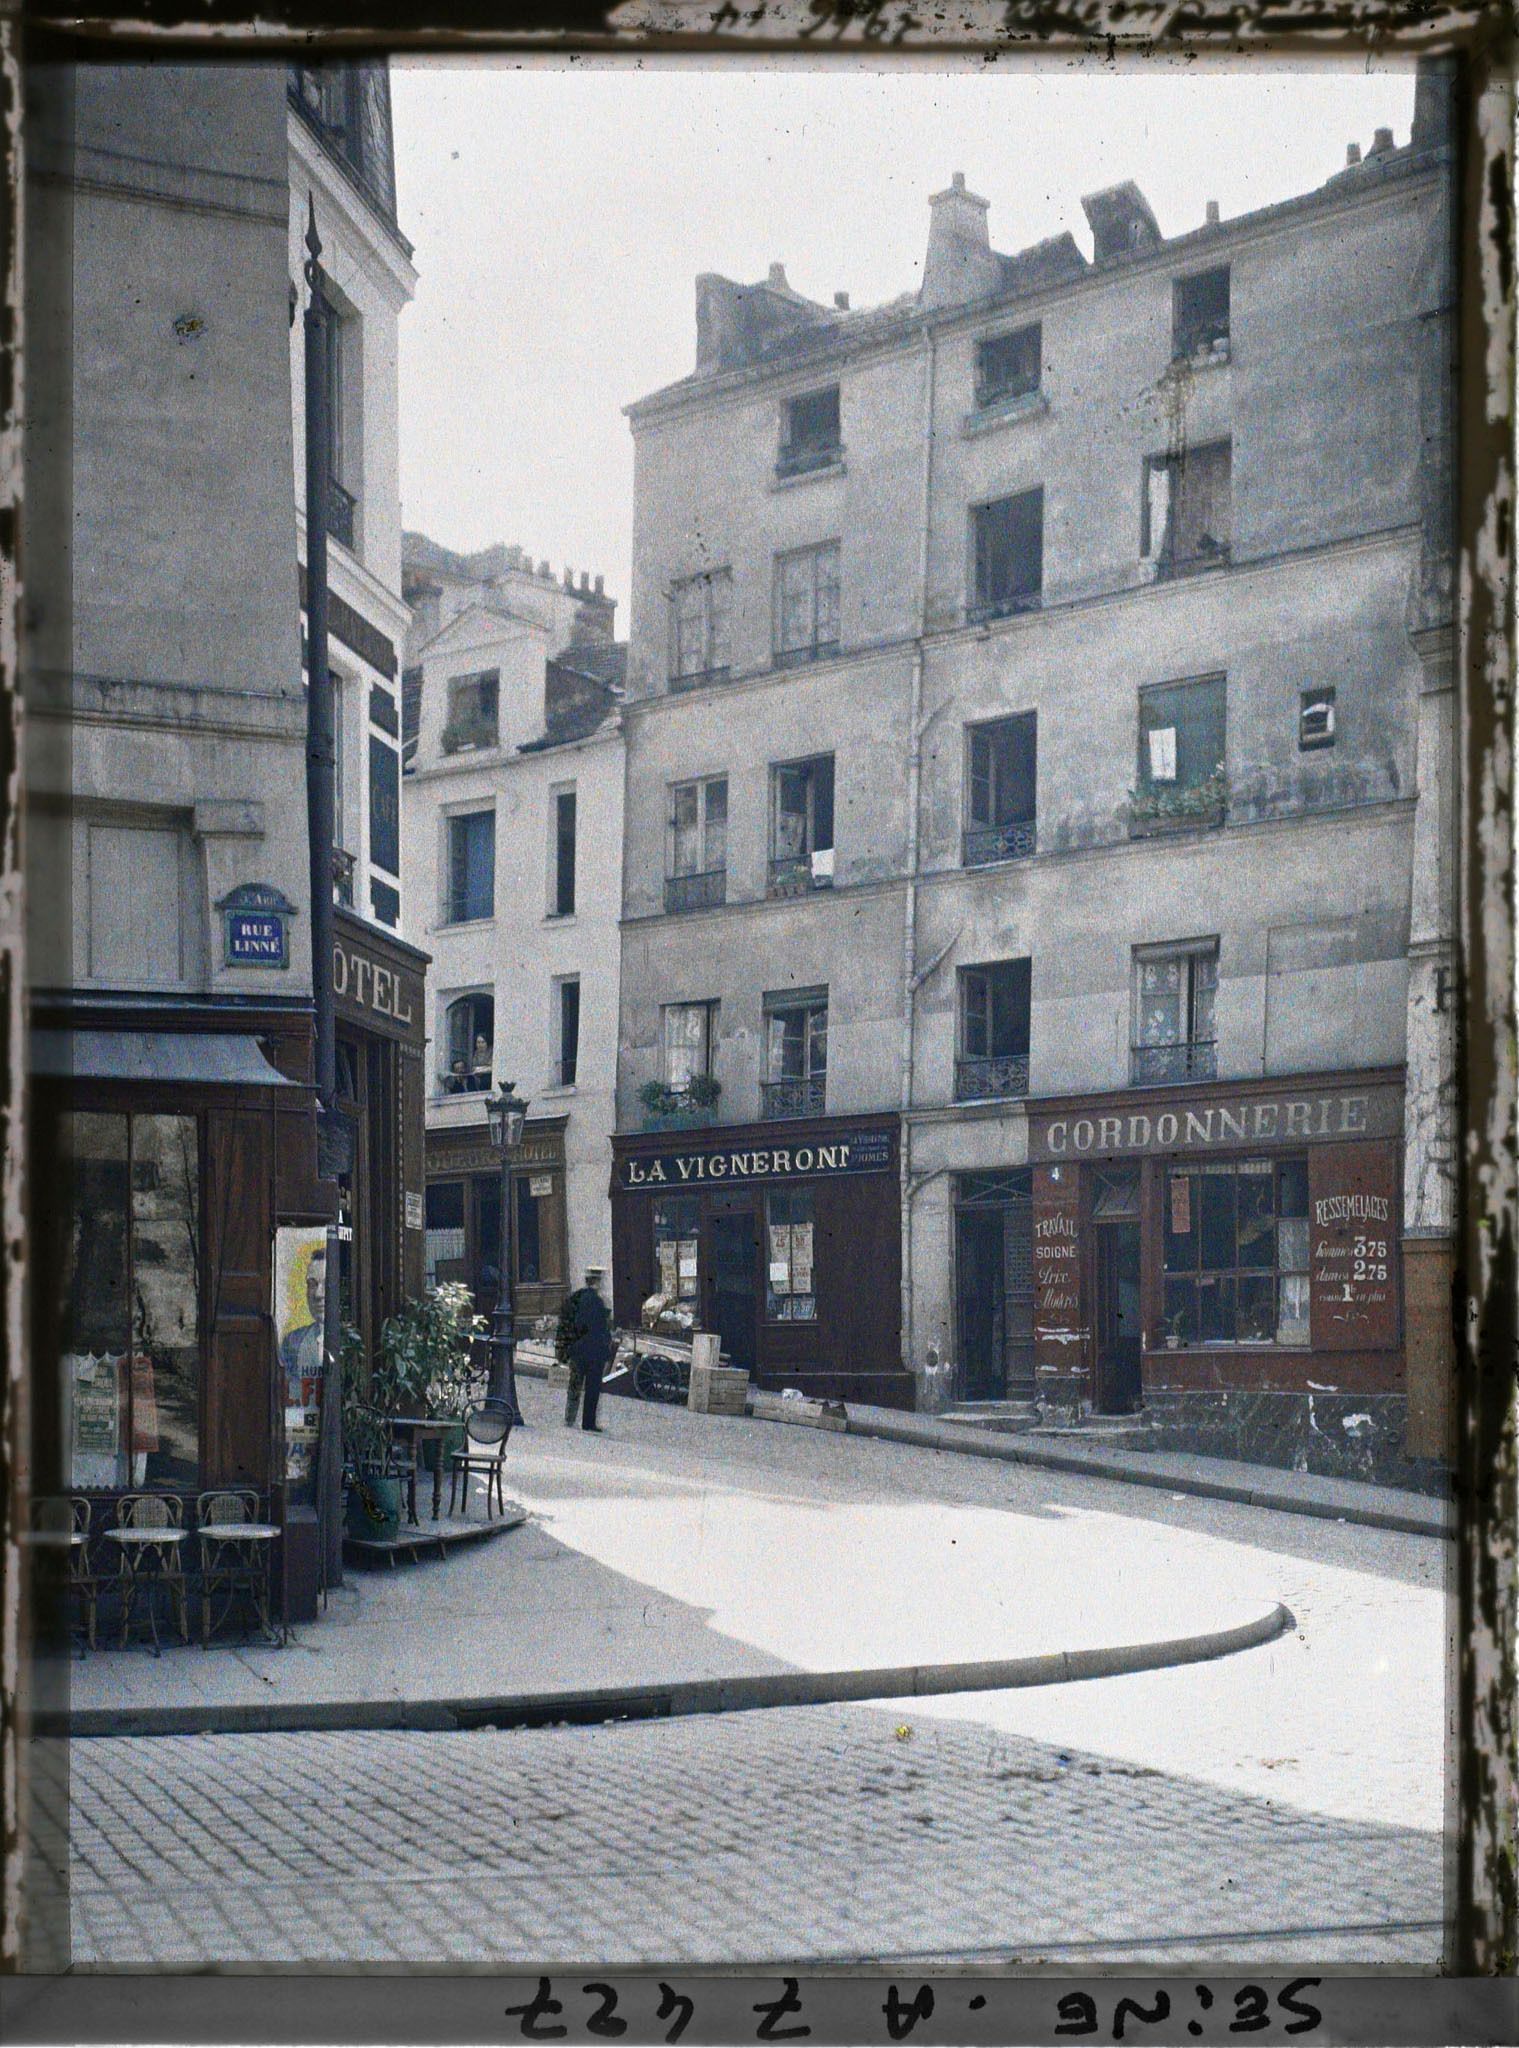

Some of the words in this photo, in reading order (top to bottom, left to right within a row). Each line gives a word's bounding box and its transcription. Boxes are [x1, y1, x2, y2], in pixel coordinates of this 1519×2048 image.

[241, 923, 273, 936] RUE
[234, 936, 280, 953] LINNÉ
[333, 943, 412, 1025] ÔTEL
[1047, 1096, 1369, 1154] CORDONNERIE
[629, 1160, 667, 1184] LA
[1051, 1167, 1060, 1181] 4
[1315, 1196, 1388, 1227] RESSEMELAGES
[1035, 1211, 1079, 1239] TRAVAIL
